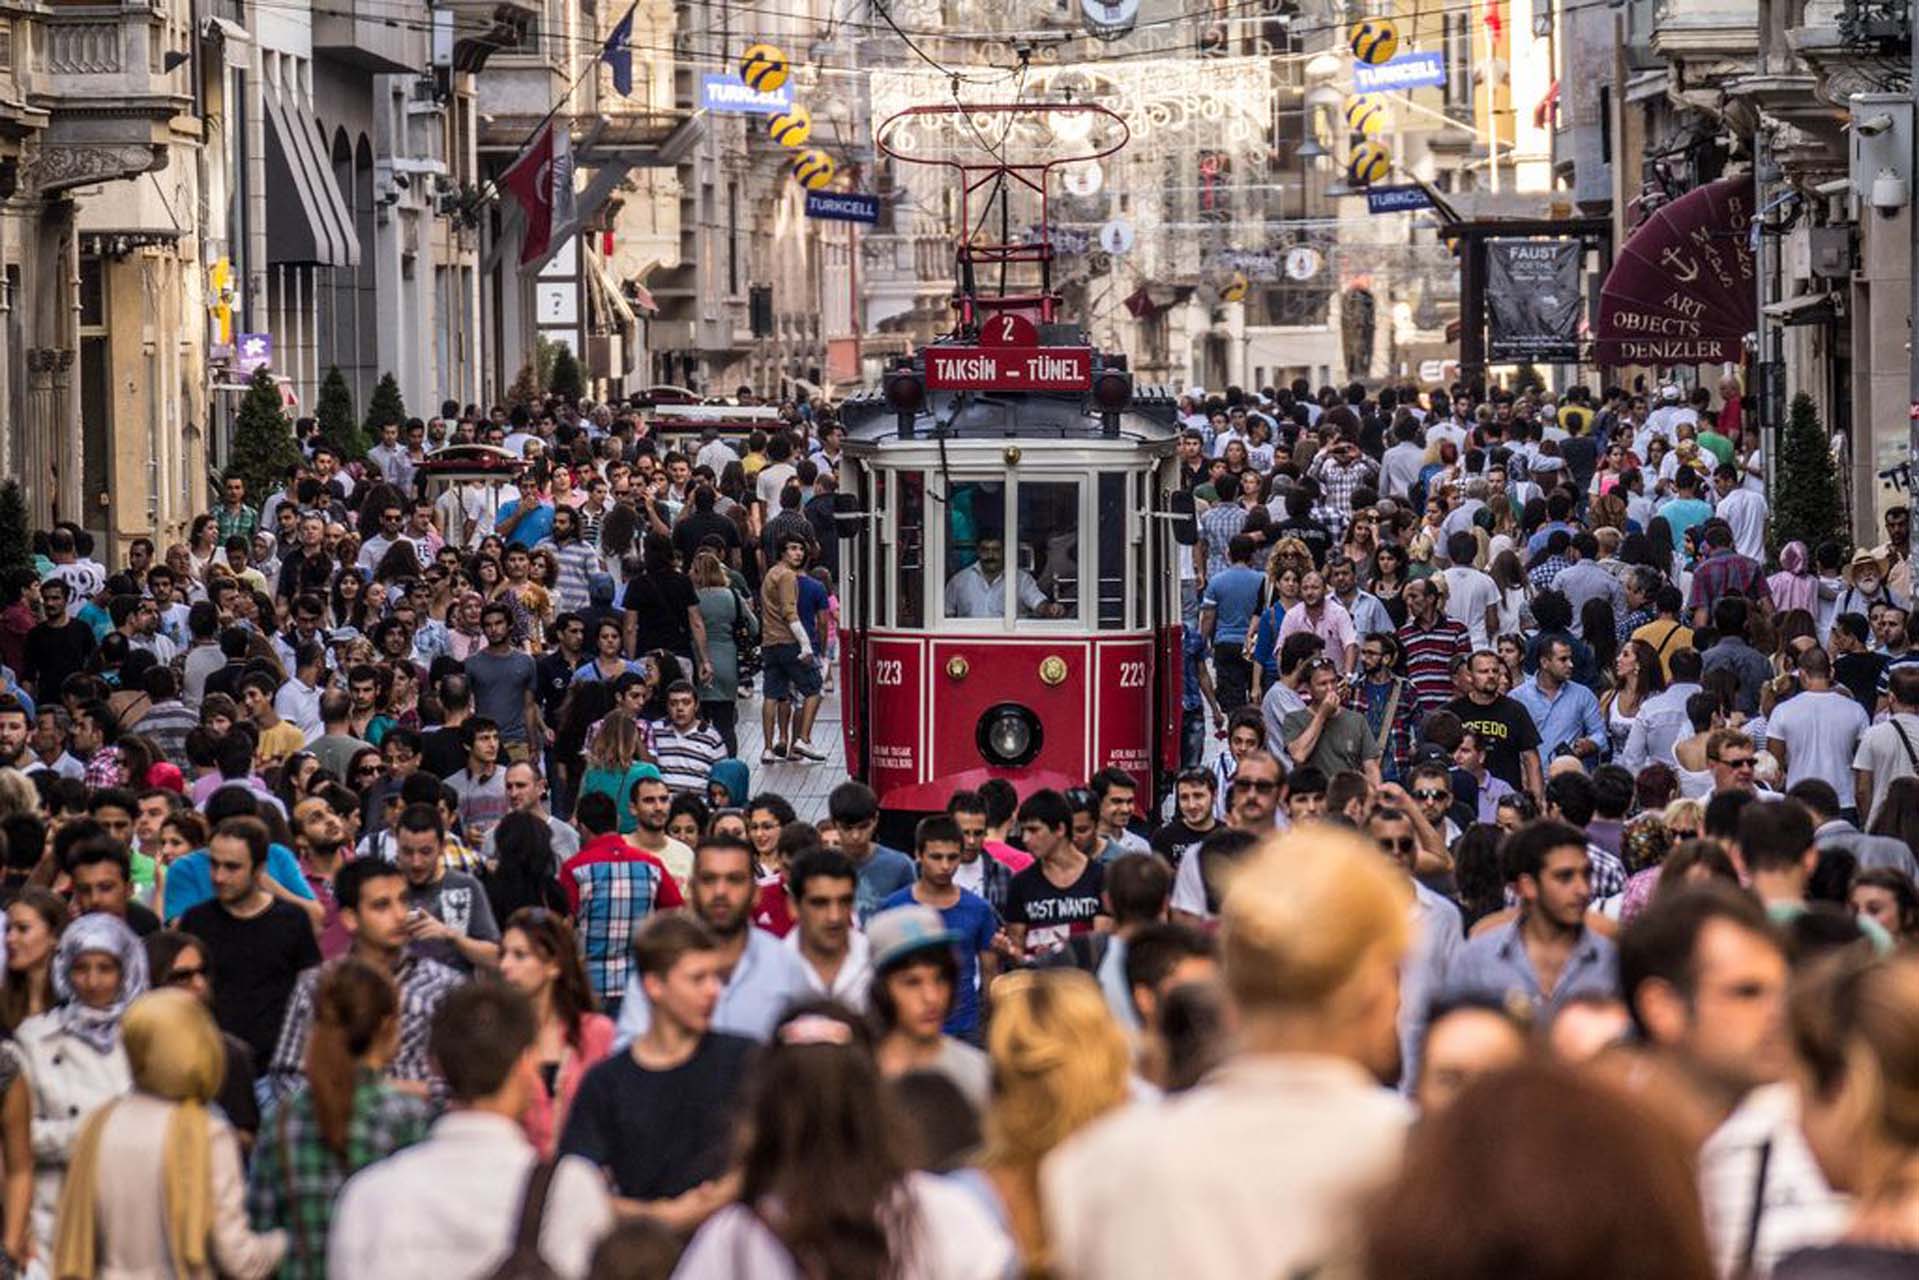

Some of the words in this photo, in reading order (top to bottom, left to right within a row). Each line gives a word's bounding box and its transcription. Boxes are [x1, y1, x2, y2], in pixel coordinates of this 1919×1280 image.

[809, 197, 874, 216] TURKCELL
[1509, 246, 1559, 259] FAUST
[1690, 225, 1733, 288] MAPS
[1664, 291, 1707, 318] ART
[1002, 316, 1015, 341] 2
[1613, 311, 1700, 337] OBJECTS
[1621, 340, 1723, 359] DENİZLER
[935, 355, 996, 380] TAKSİM
[1027, 355, 1085, 381] TÜNEL
[876, 660, 903, 685] 223
[1120, 662, 1146, 688] 223
